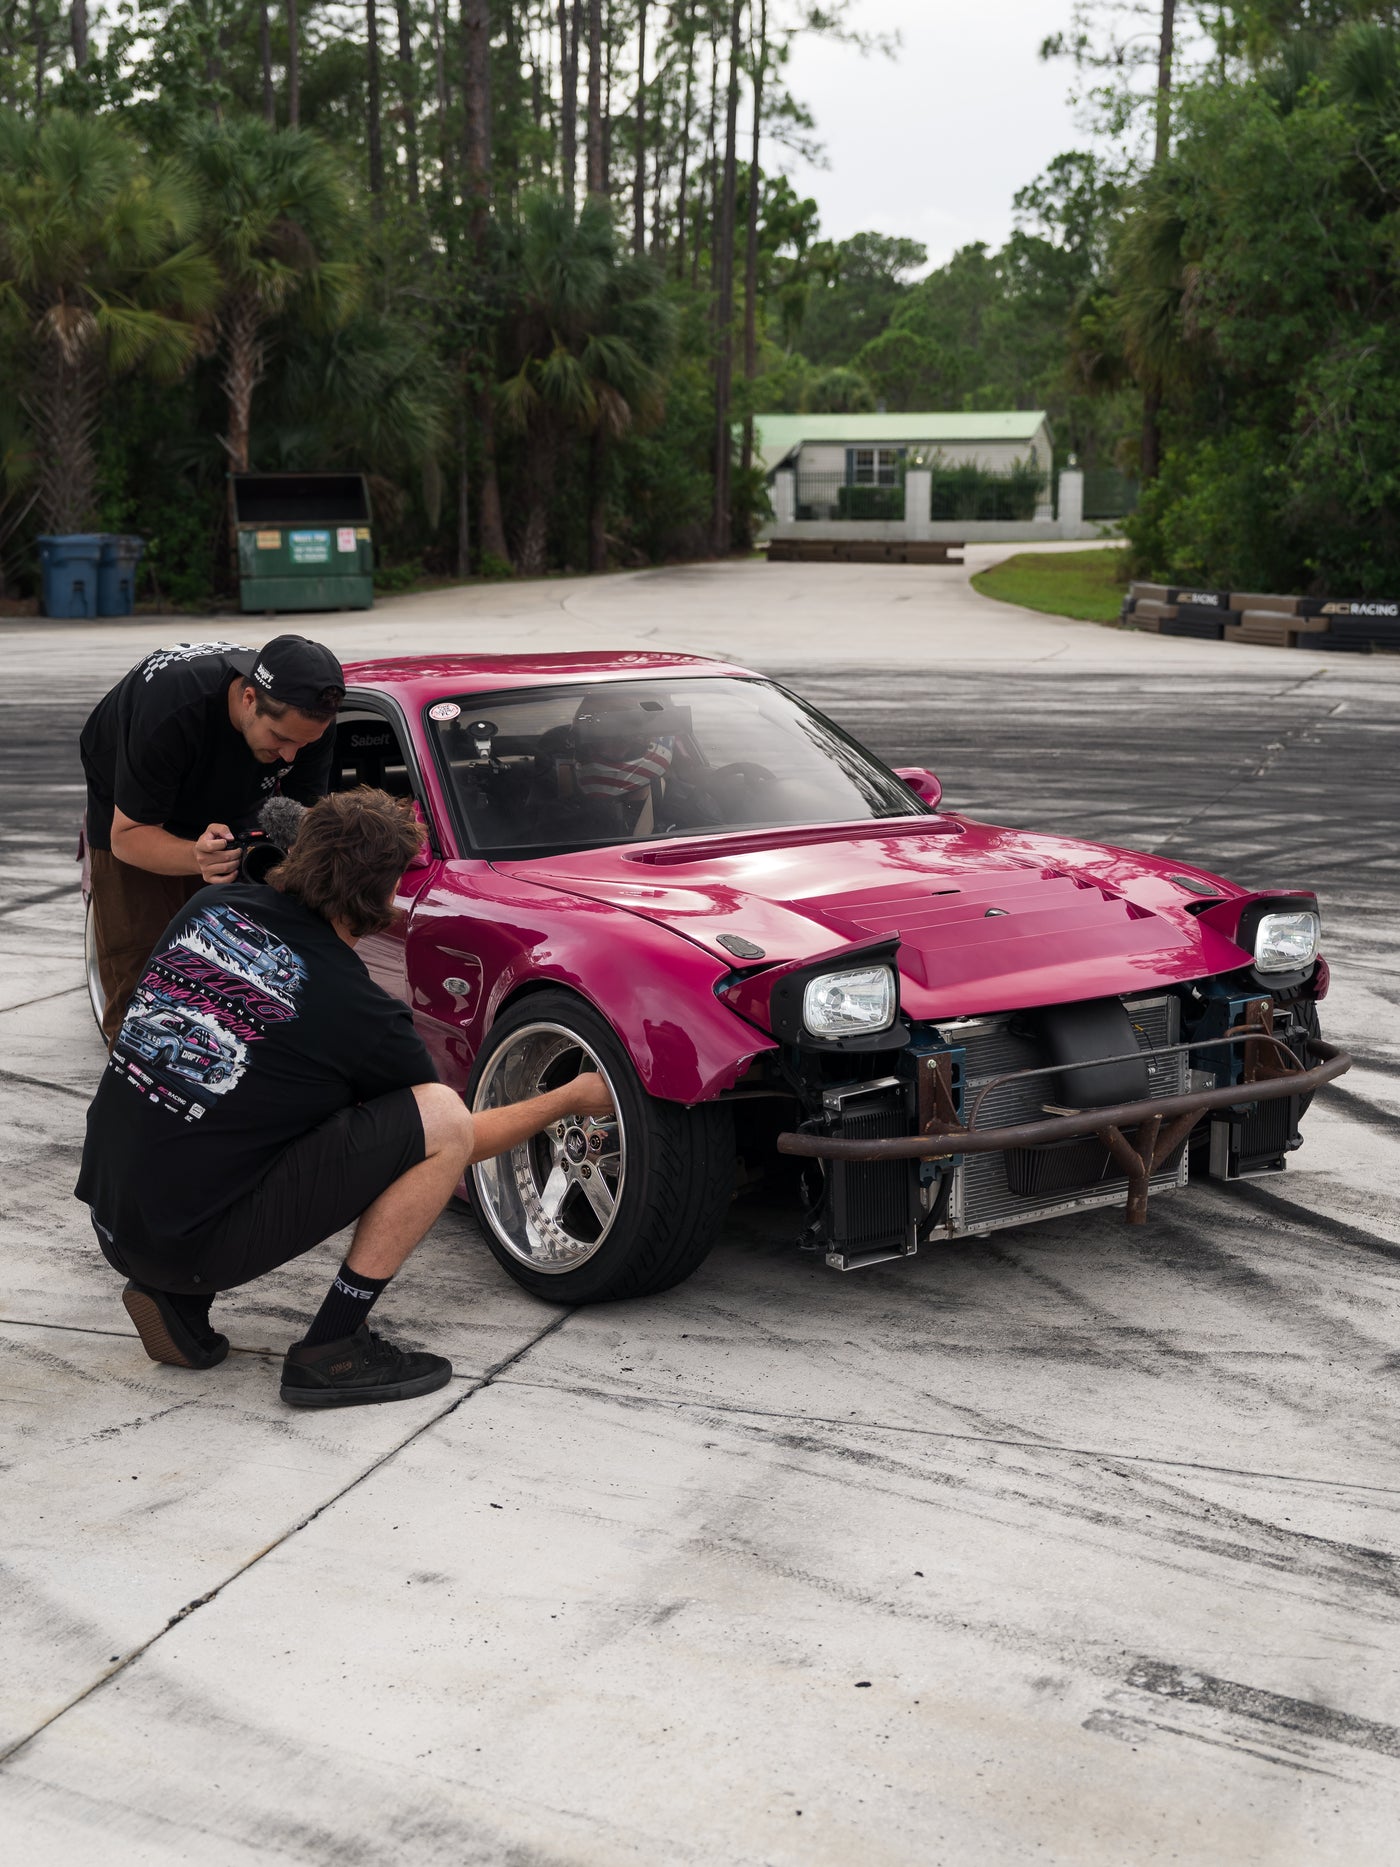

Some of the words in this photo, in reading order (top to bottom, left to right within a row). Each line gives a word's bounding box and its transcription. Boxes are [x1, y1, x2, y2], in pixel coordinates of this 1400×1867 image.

[351, 734, 390, 748] Sabelt
[151, 963, 266, 1031] INTERNATIONAL
[334, 1276, 374, 1300] ANS
